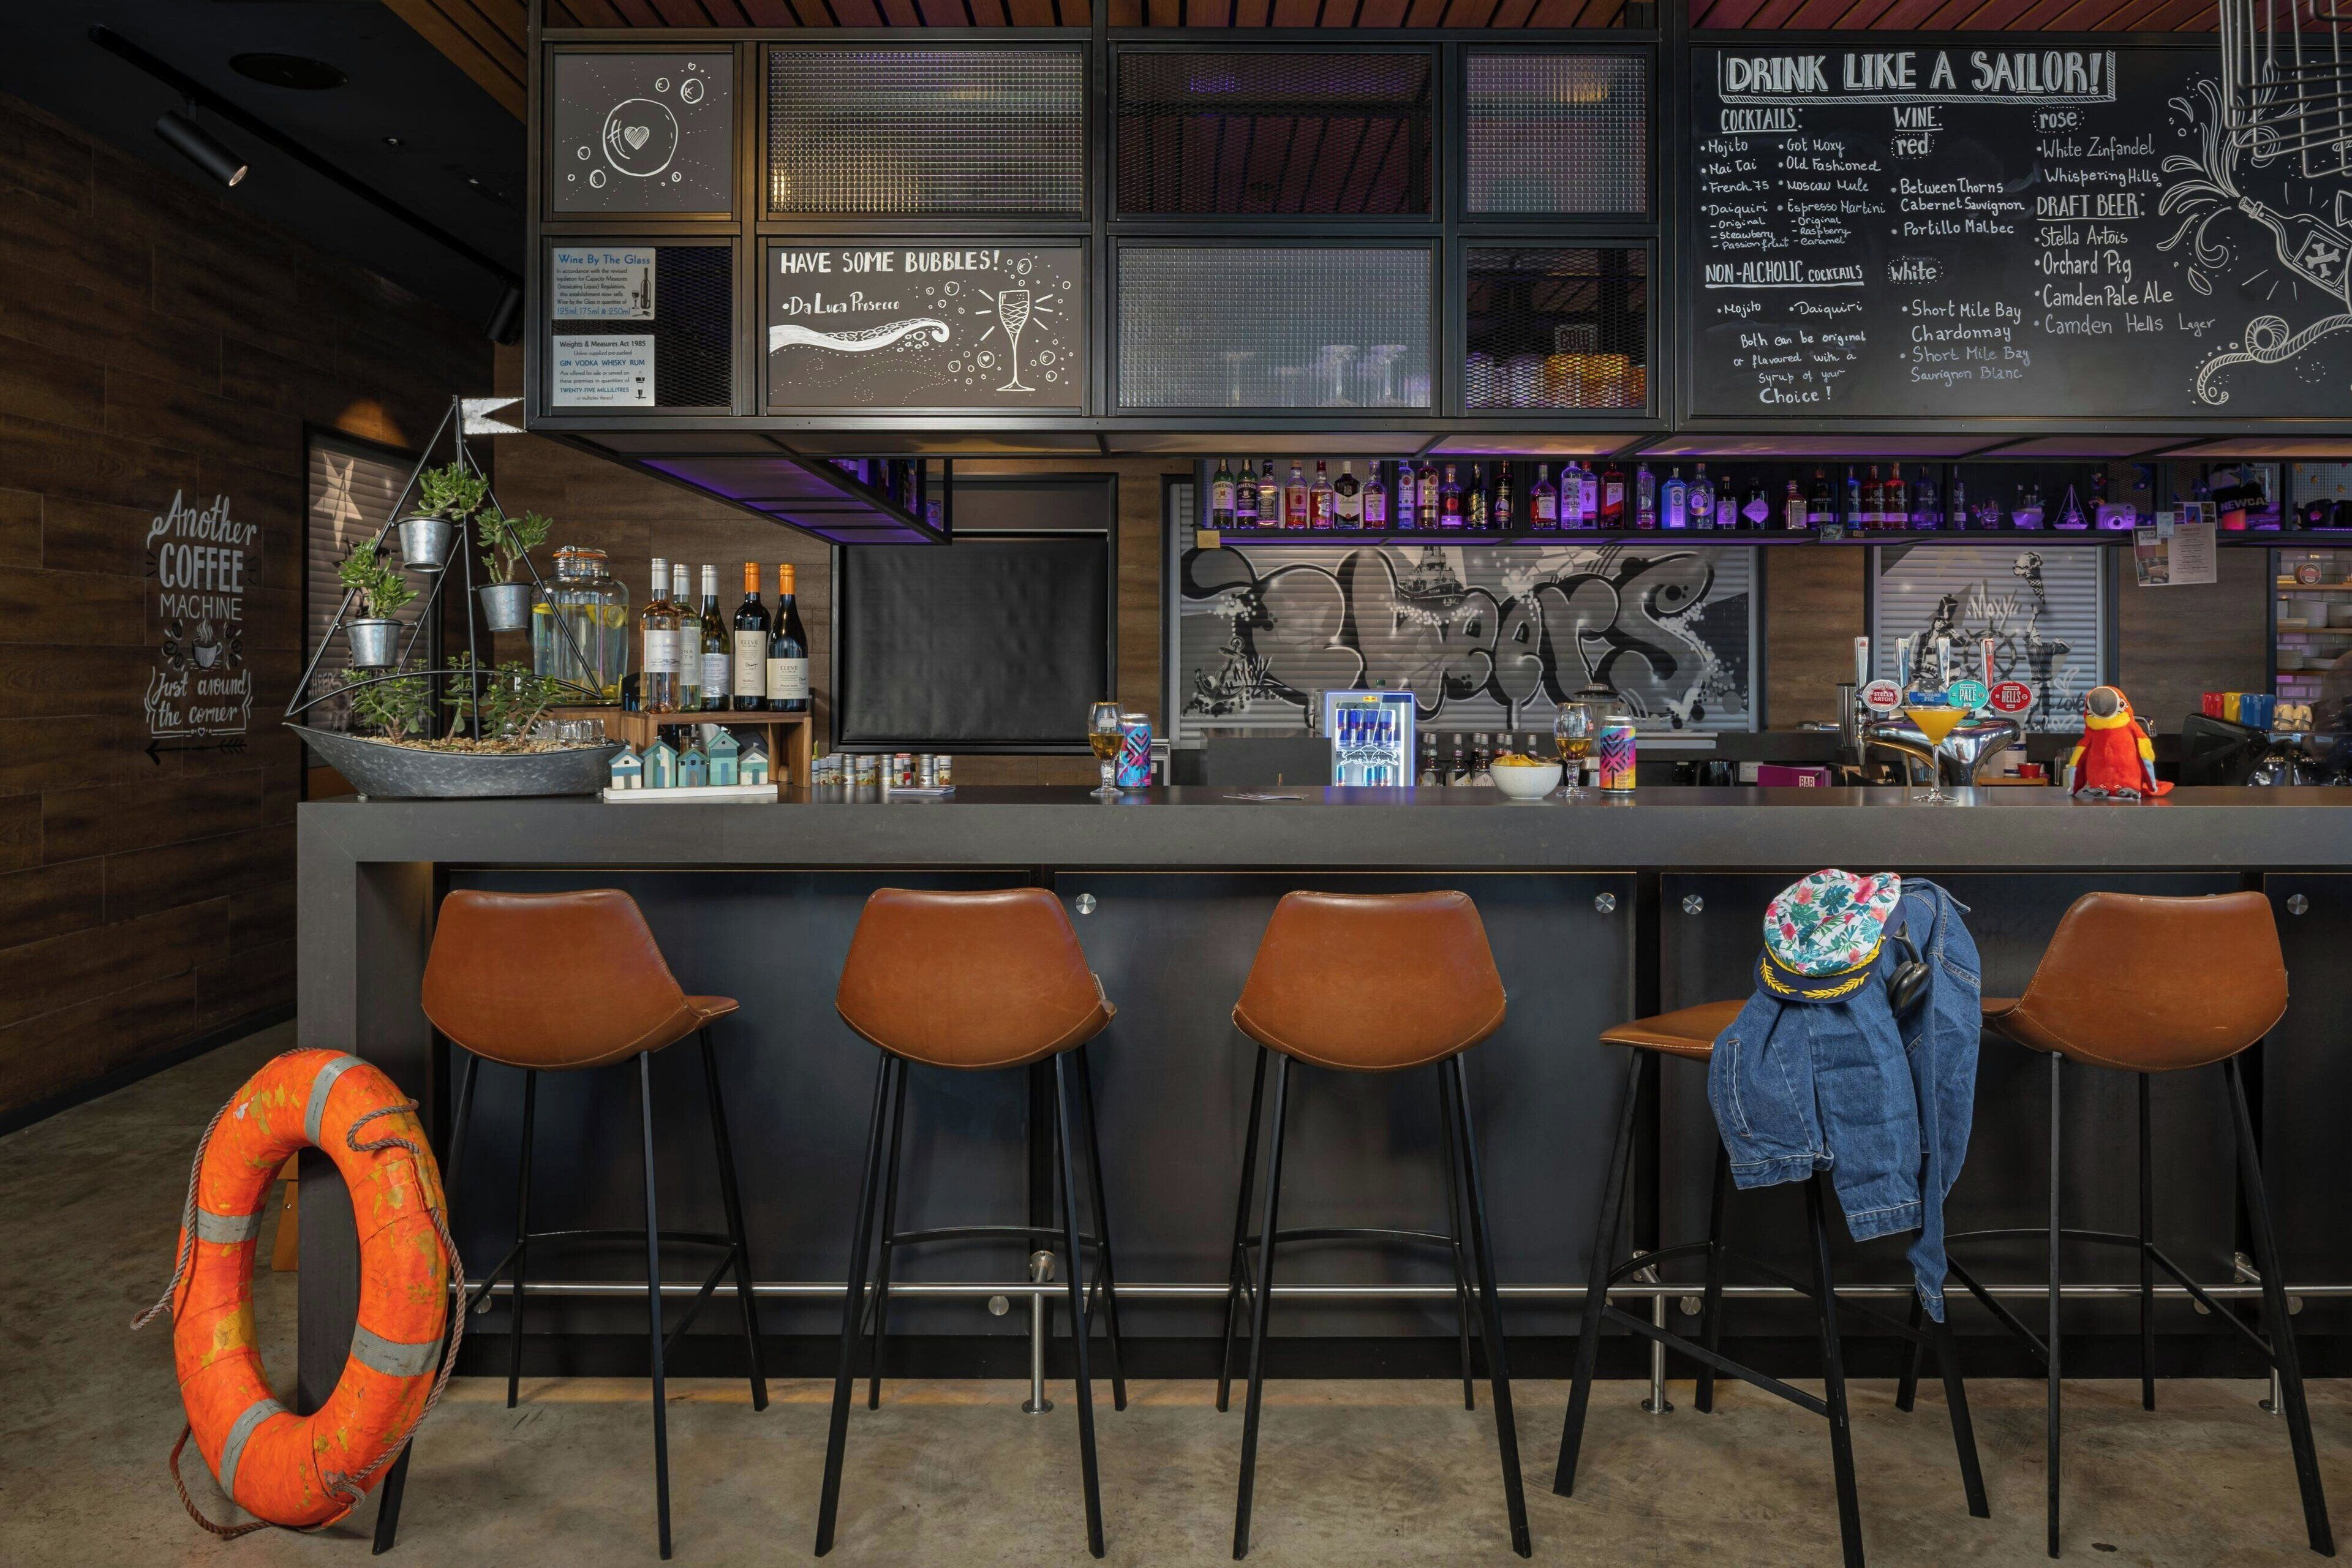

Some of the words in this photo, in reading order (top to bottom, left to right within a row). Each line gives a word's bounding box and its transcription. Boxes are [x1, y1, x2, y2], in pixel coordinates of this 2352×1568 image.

[1727, 56, 1828, 92] DRINK
[1844, 51, 1917, 89] LIKE
[1930, 50, 1957, 89] A
[1971, 51, 2104, 95] SAILOR!
[1721, 108, 1803, 131] COCKTAILS:
[1894, 105, 1943, 127] WINE:
[2040, 112, 2077, 129] rose
[1708, 137, 1747, 157] Mojito
[1787, 138, 1807, 151] Got
[1814, 138, 1845, 157] Moxy
[1896, 132, 1928, 155] red
[2043, 137, 2082, 157] White
[2087, 134, 2155, 160] Zinfandel
[1709, 163, 1732, 175] Mai
[1787, 156, 1808, 170] Old
[1812, 158, 1881, 171] Fashioned
[1837, 178, 1869, 192] Mule
[1900, 178, 1956, 194] Between
[1957, 178, 2003, 193] Thorns
[2045, 167, 2125, 187] Whispering
[2128, 168, 2159, 183] Hills
[1709, 181, 1752, 193] French
[1752, 181, 1769, 190] 75
[1709, 202, 1768, 217] Daiquiri
[1787, 199, 1837, 217] Espresso
[1841, 200, 1885, 214] Martini
[1901, 197, 1962, 212] Cabernet
[1964, 197, 2025, 216] Sauvignon
[2037, 195, 2090, 216] DRAFT
[2097, 193, 2145, 216] BEER:
[1719, 217, 1765, 228] Original
[1798, 217, 1841, 228] Original
[1904, 220, 1960, 236] Portillo
[1966, 219, 2014, 233] Malbec
[1801, 236, 1845, 246] Caramel
[2041, 225, 2079, 246] Stella
[2087, 225, 2128, 244] Artois
[558, 254, 583, 264] Wine
[587, 254, 599, 266] By
[603, 254, 620, 264] The
[624, 254, 650, 264] Glass
[781, 252, 831, 274] HAVE
[842, 251, 894, 272] SOME
[905, 250, 1001, 273] BUBBLES!
[2043, 249, 2098, 274] Orchard
[2103, 249, 2132, 283] Pig
[1808, 265, 1863, 282] COCKTAILS
[790, 296, 812, 315] Da
[814, 292, 847, 314] Luca
[850, 291, 900, 311] Prosecco
[2043, 282, 2103, 307] Camden
[2104, 284, 2139, 306] Pale
[2144, 281, 2174, 304] Ale
[1725, 301, 1761, 318] Mojito
[1794, 301, 1863, 319] Daiquiri
[1912, 299, 1954, 317] Short
[1961, 301, 1989, 317] Mile
[1996, 302, 2021, 325] Bay
[1912, 323, 2011, 342] Chardonnay
[2045, 313, 2113, 336] Camden
[2126, 312, 2164, 333] Hells
[2179, 312, 2215, 337] Lager
[1740, 333, 1768, 348] Both
[1774, 336, 1792, 346] can
[1800, 330, 1814, 344] be
[1822, 331, 1866, 346] original
[1752, 352, 1801, 369] flavoured
[1814, 353, 1839, 362] with
[1913, 345, 1959, 362] Short
[1967, 346, 1997, 361] Mile
[2003, 346, 2030, 366] Bay
[1803, 371, 1812, 382] of
[1821, 369, 1845, 383] your
[1911, 366, 1972, 388] Sauvignon
[1980, 366, 2022, 379] Blanc
[147, 489, 257, 549] Another
[159, 543, 244, 593] COFFEE
[160, 593, 243, 621] MACHINE
[152, 671, 187, 705] Just
[197, 669, 246, 696] around
[1959, 689, 1977, 701] PALE
[2002, 690, 2021, 703] HELLS
[159, 701, 181, 728] the
[189, 704, 238, 724] corner
